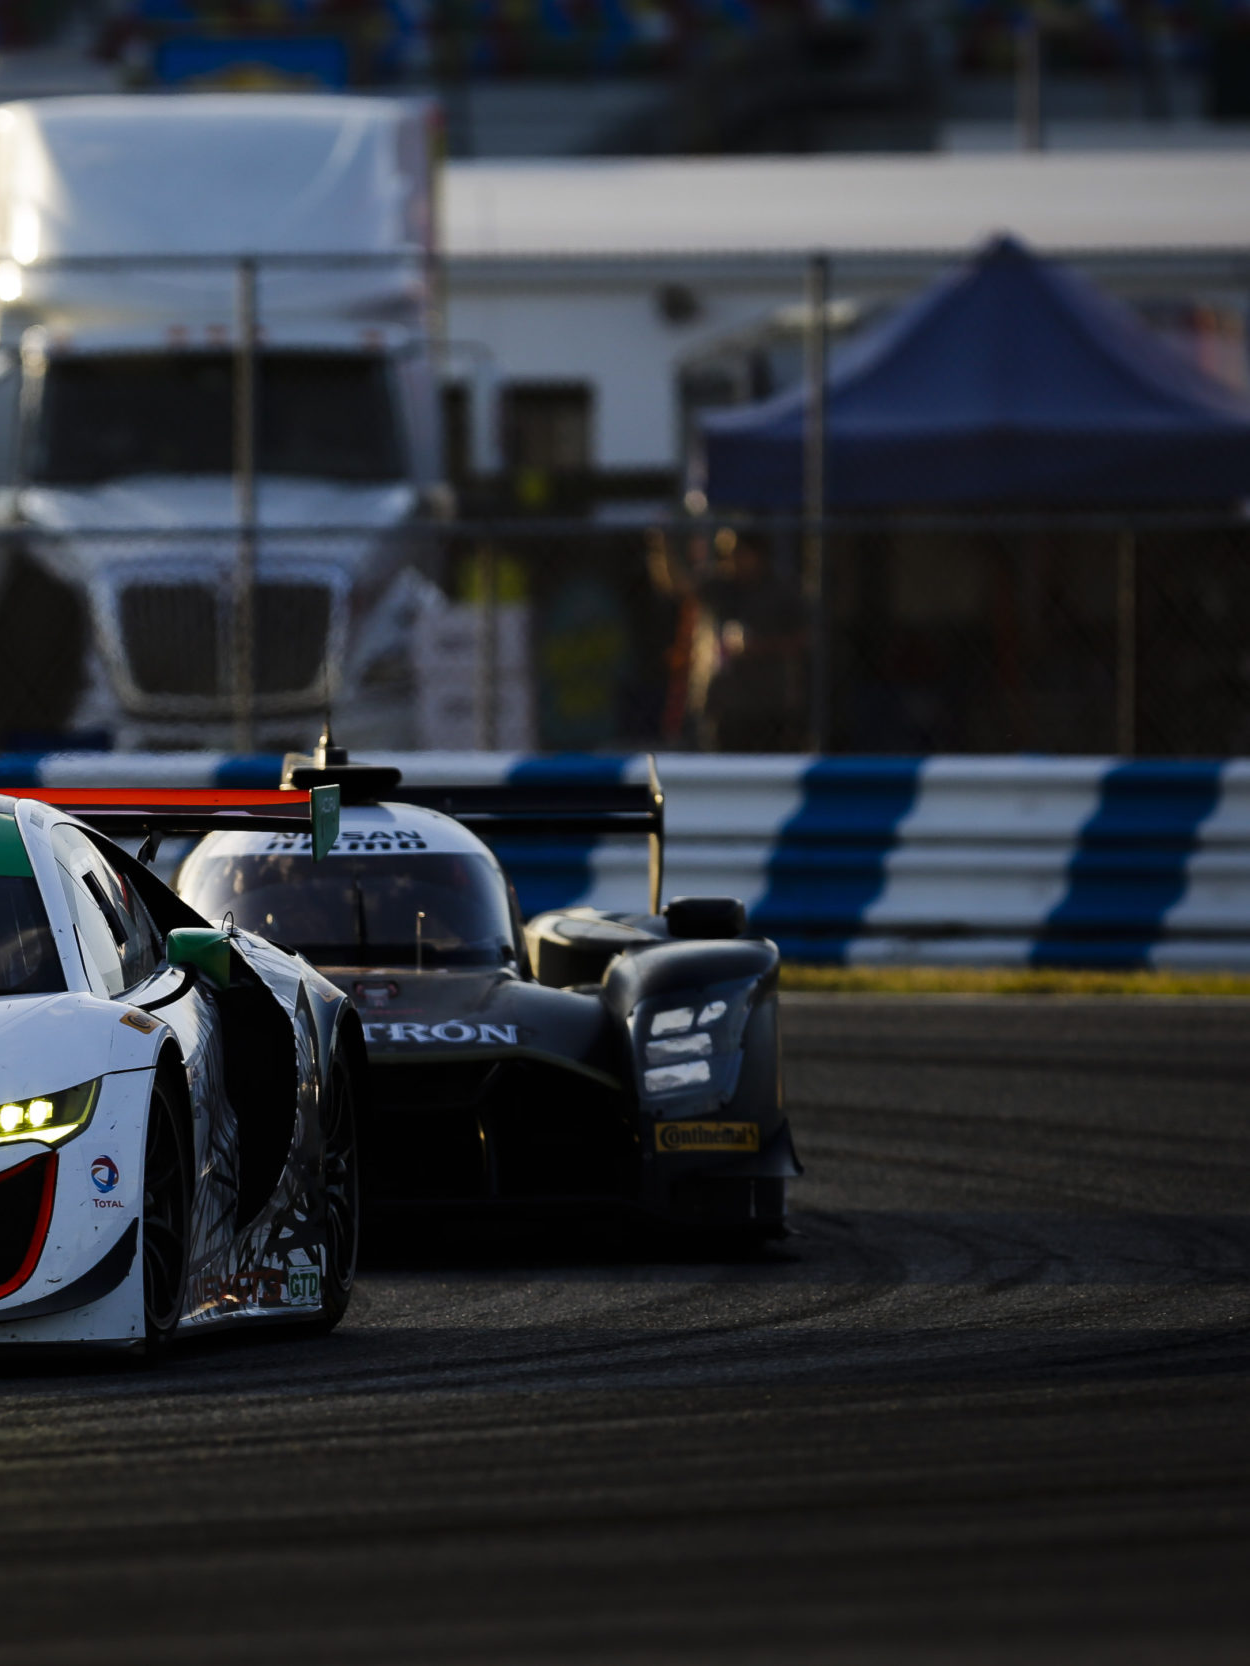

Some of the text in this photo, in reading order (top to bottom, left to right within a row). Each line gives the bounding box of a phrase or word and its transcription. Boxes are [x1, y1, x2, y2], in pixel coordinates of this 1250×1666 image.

[271, 830, 422, 841] NISAN
[266, 841, 427, 851] nimo
[92, 1198, 125, 1208] TOTAL
[290, 1272, 318, 1298] GTD
